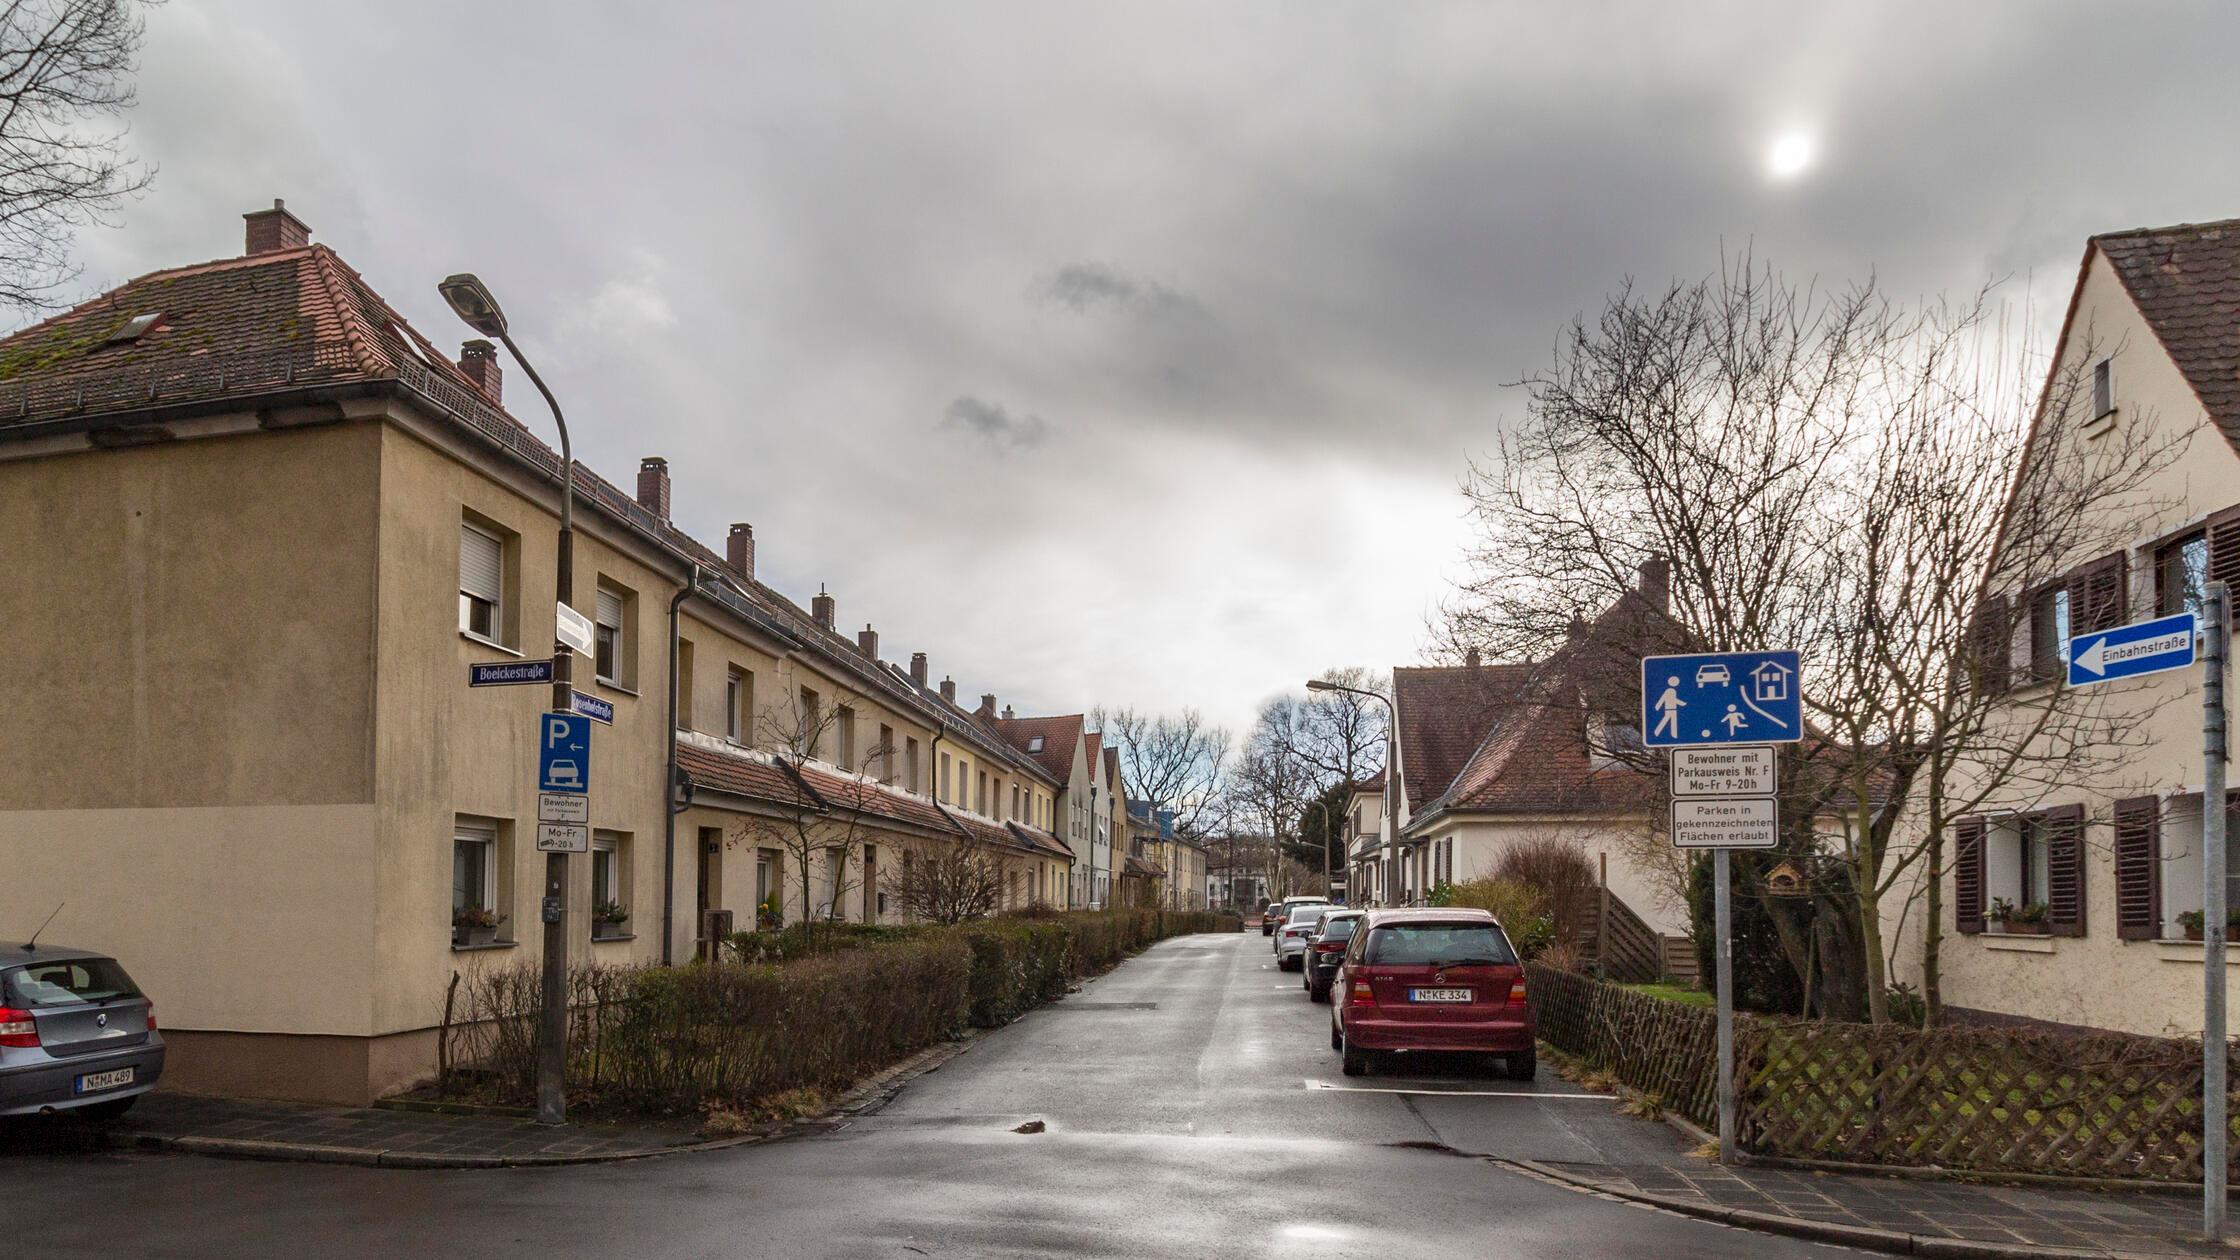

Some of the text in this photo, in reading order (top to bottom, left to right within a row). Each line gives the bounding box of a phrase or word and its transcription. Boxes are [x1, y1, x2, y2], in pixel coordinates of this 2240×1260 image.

[2102, 637, 2186, 662] Einbahnstraße
[480, 664, 544, 680] Boelckestraße
[549, 719, 570, 749] P
[1688, 752, 1758, 764] Bewohner mit
[1678, 765, 1769, 777] Parkausweis Nr. F
[1689, 780, 1721, 790] Mo-Fr
[544, 798, 583, 808] Bewohner
[1697, 806, 1751, 815] Parken in
[1676, 819, 1773, 830] gekennzeichneten
[548, 827, 577, 838] Mo-Fr
[1680, 831, 1769, 841] Flächen erlaubt
[1419, 990, 1467, 1000] N KE 334
[87, 1070, 130, 1089] N MA 489
